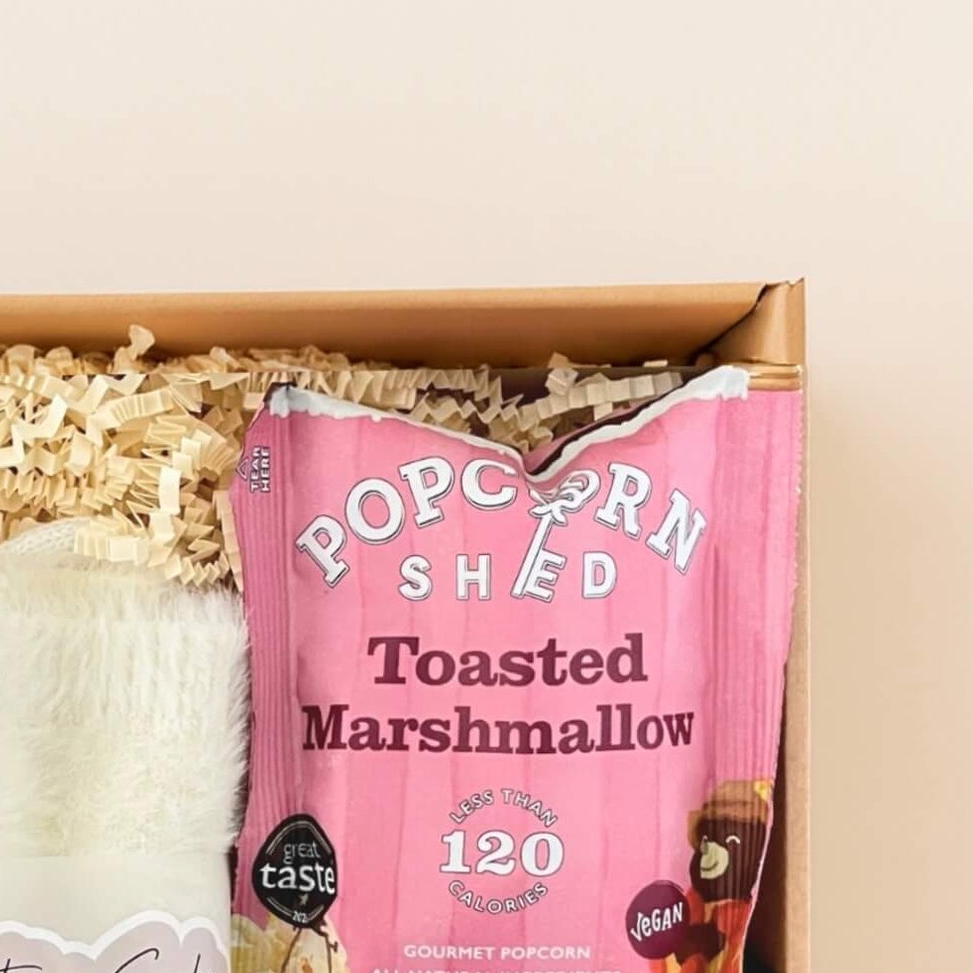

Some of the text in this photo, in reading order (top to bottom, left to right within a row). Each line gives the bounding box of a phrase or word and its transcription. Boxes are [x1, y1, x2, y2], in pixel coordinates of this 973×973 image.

[250, 446, 261, 493] TEAR
[260, 446, 271, 493] HERE
[295, 456, 707, 588] POPCORN
[398, 550, 618, 603] SHED
[367, 633, 648, 687] Toasted
[302, 703, 695, 755] Marshmallow
[450, 788, 558, 828] LESS THAN
[283, 841, 321, 865] great
[439, 829, 565, 878] 120
[259, 862, 336, 895] taste
[448, 880, 548, 915] CALORIES
[403, 945, 591, 961] GOURMET POPCORN
